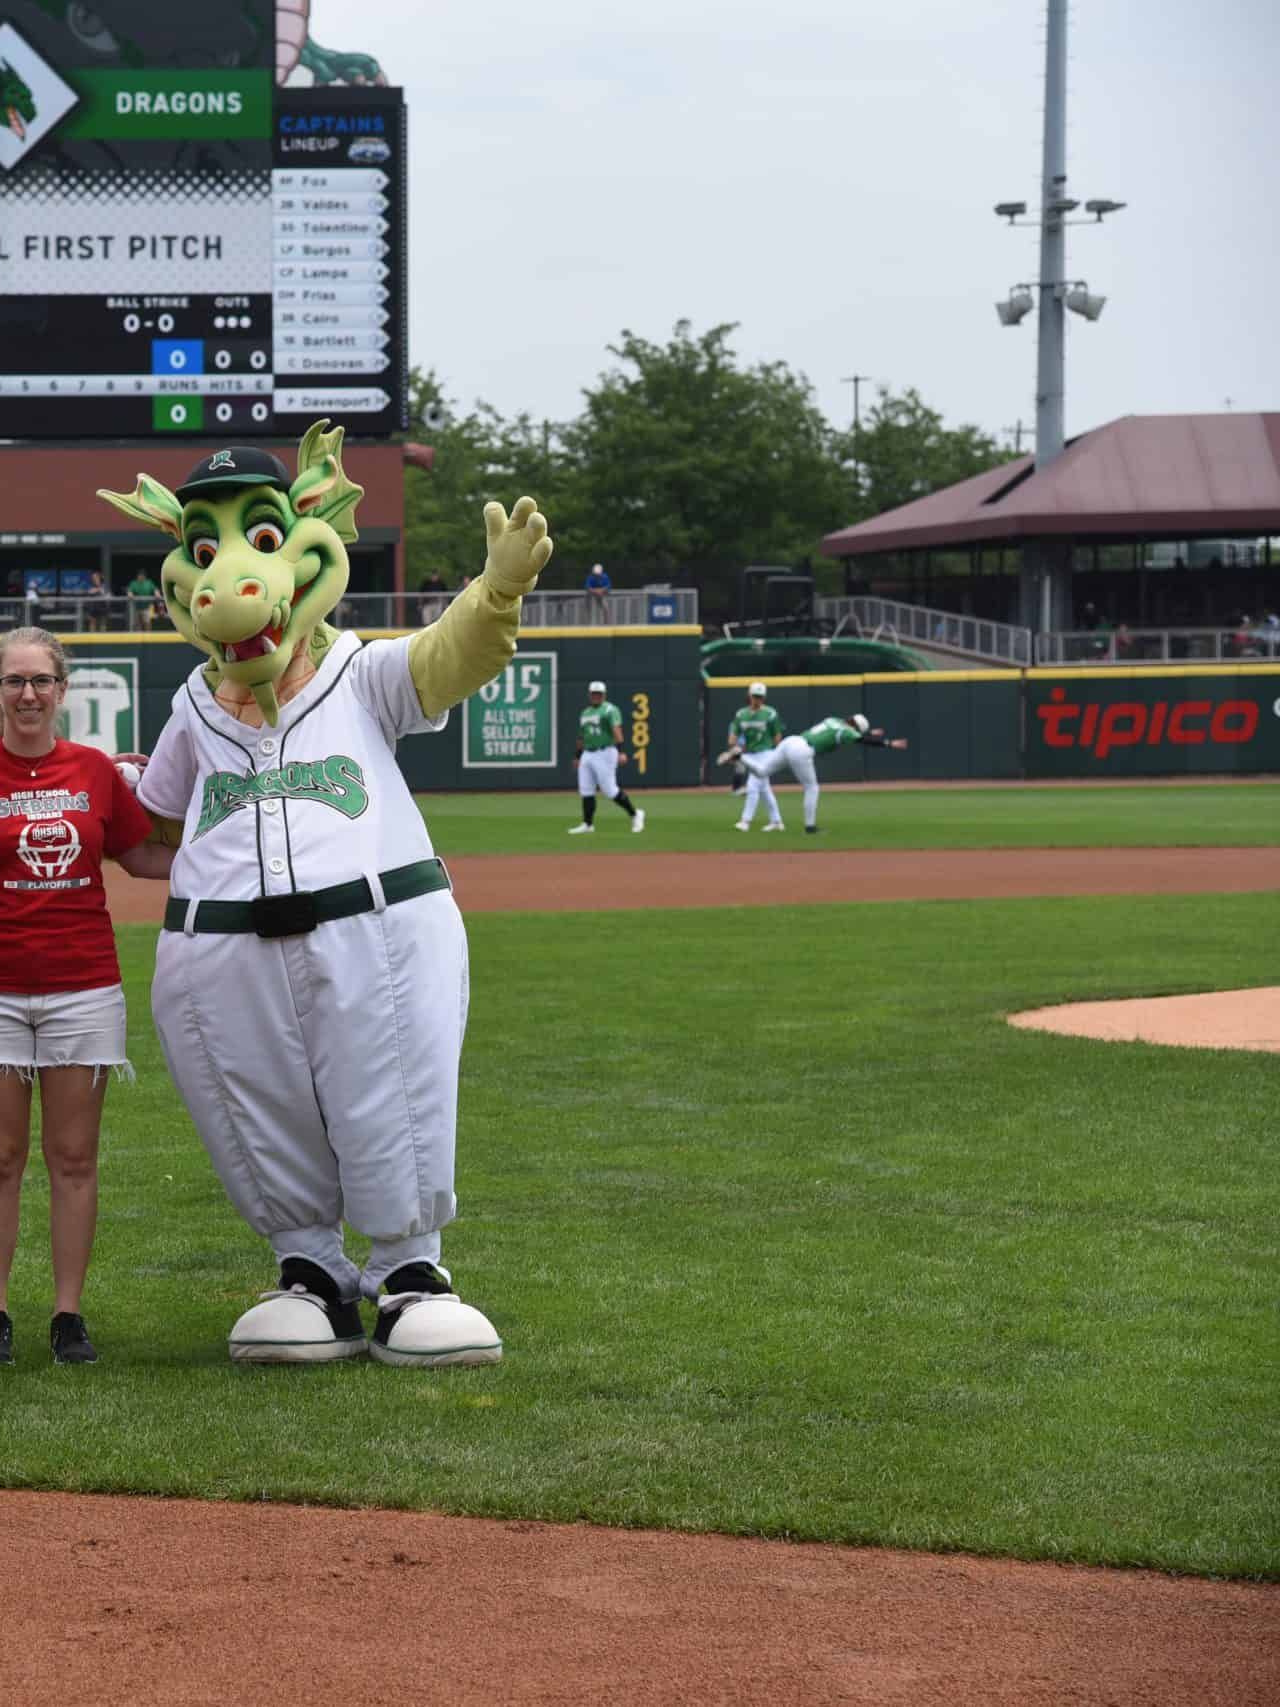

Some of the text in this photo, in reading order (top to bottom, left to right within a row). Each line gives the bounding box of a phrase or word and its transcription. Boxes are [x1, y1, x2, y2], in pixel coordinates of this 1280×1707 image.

[115, 91, 243, 114] DRAGONS
[279, 116, 386, 133] CAPTAINS
[280, 137, 339, 152] LINEUP
[24, 235, 116, 260] FIRST
[129, 235, 223, 260] PITCH
[107, 298, 189, 308] BALL STRIKE
[215, 297, 250, 308] OUTS
[169, 350, 186, 368] 0
[215, 350, 231, 368] 0
[250, 351, 266, 368] 0
[159, 381, 199, 390] RUNS
[210, 381, 243, 390] HITS
[170, 404, 187, 423] 0
[216, 402, 232, 421] 0
[252, 402, 268, 421] 0
[483, 709, 536, 723] ALL TIME
[1037, 686, 1259, 758] tipico
[483, 725, 537, 740] SELLOUT
[631, 693, 650, 774] 381
[484, 741, 534, 756] STREAK
[11, 789, 69, 800] HIGH SCHOOL
[190, 755, 368, 843] DRAGONS
[28, 880, 72, 889] PLAYOFFS
